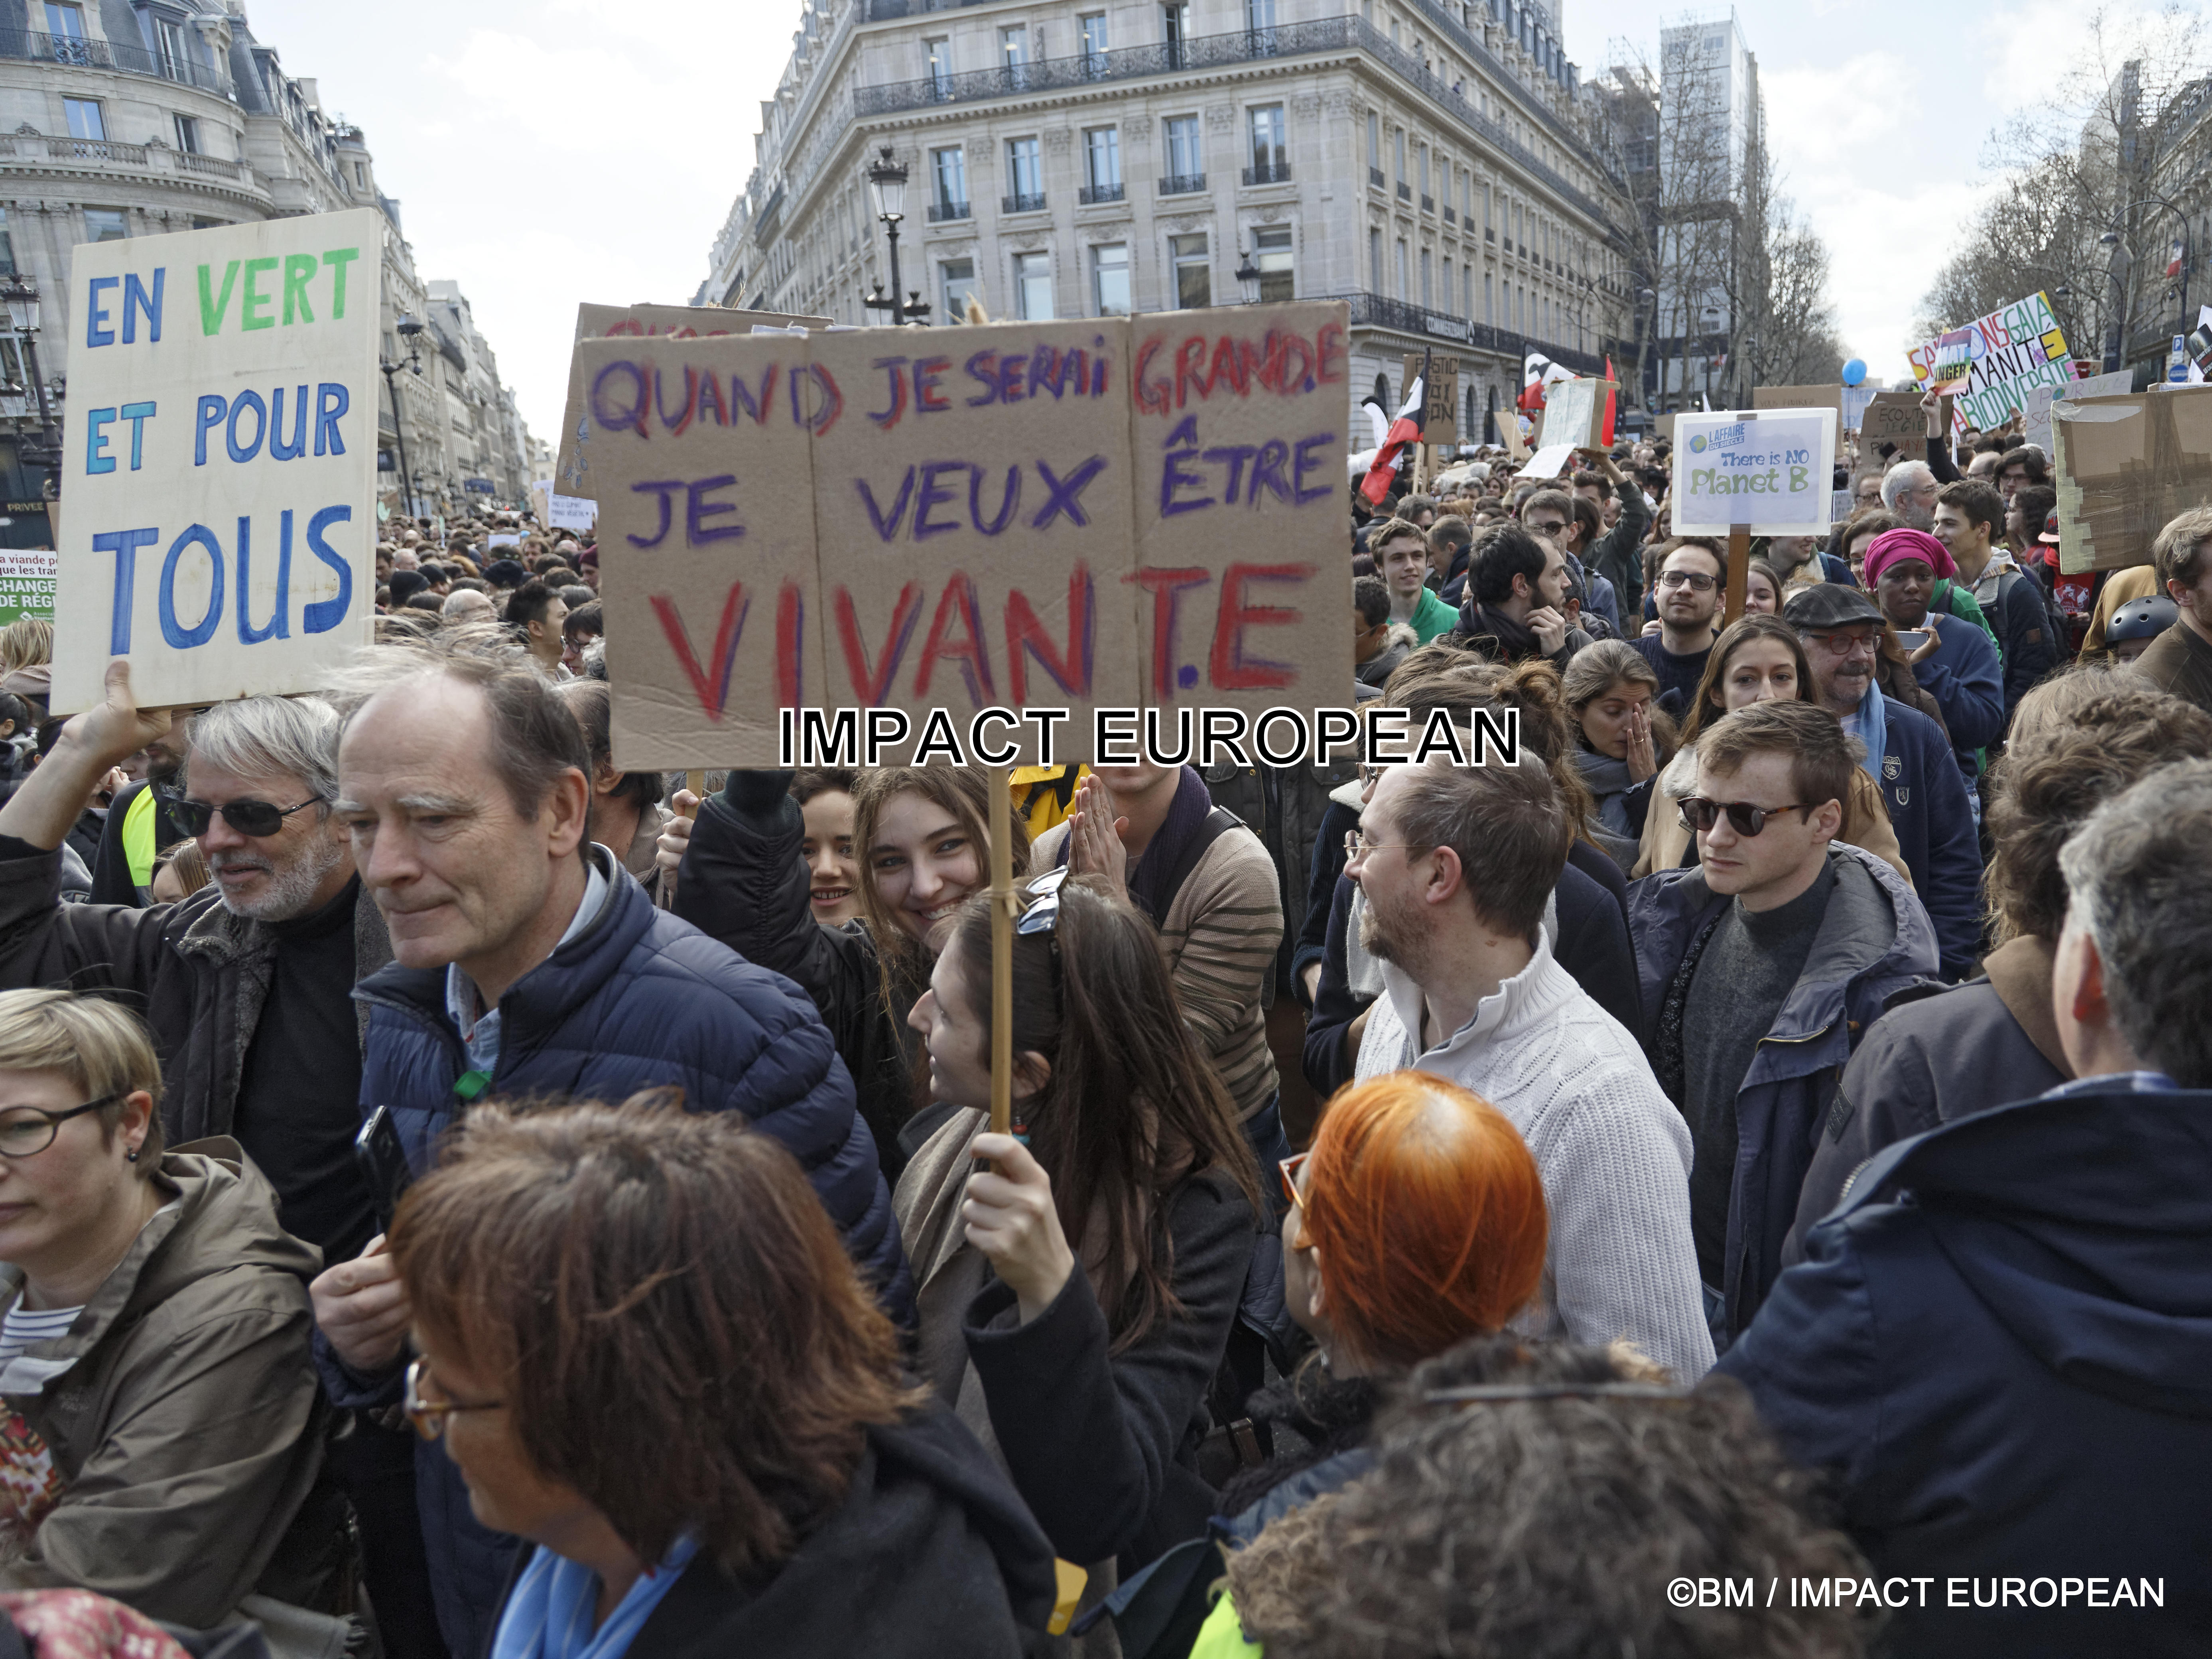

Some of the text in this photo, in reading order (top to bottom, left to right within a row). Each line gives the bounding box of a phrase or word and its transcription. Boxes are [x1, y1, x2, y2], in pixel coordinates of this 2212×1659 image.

[87, 247, 359, 348] EN VERT
[592, 359, 845, 439] QUAND
[865, 355, 953, 430] JE
[87, 383, 349, 475] ET POUR
[1710, 441, 1719, 450] DU
[627, 414, 1337, 551] JE VEUX ÊTRE
[1690, 465, 1808, 495] Planet B
[1721, 449, 1809, 467] There is NO
[9, 554, 45, 564] viande
[19, 565, 35, 575] les
[93, 505, 353, 656] TOUS
